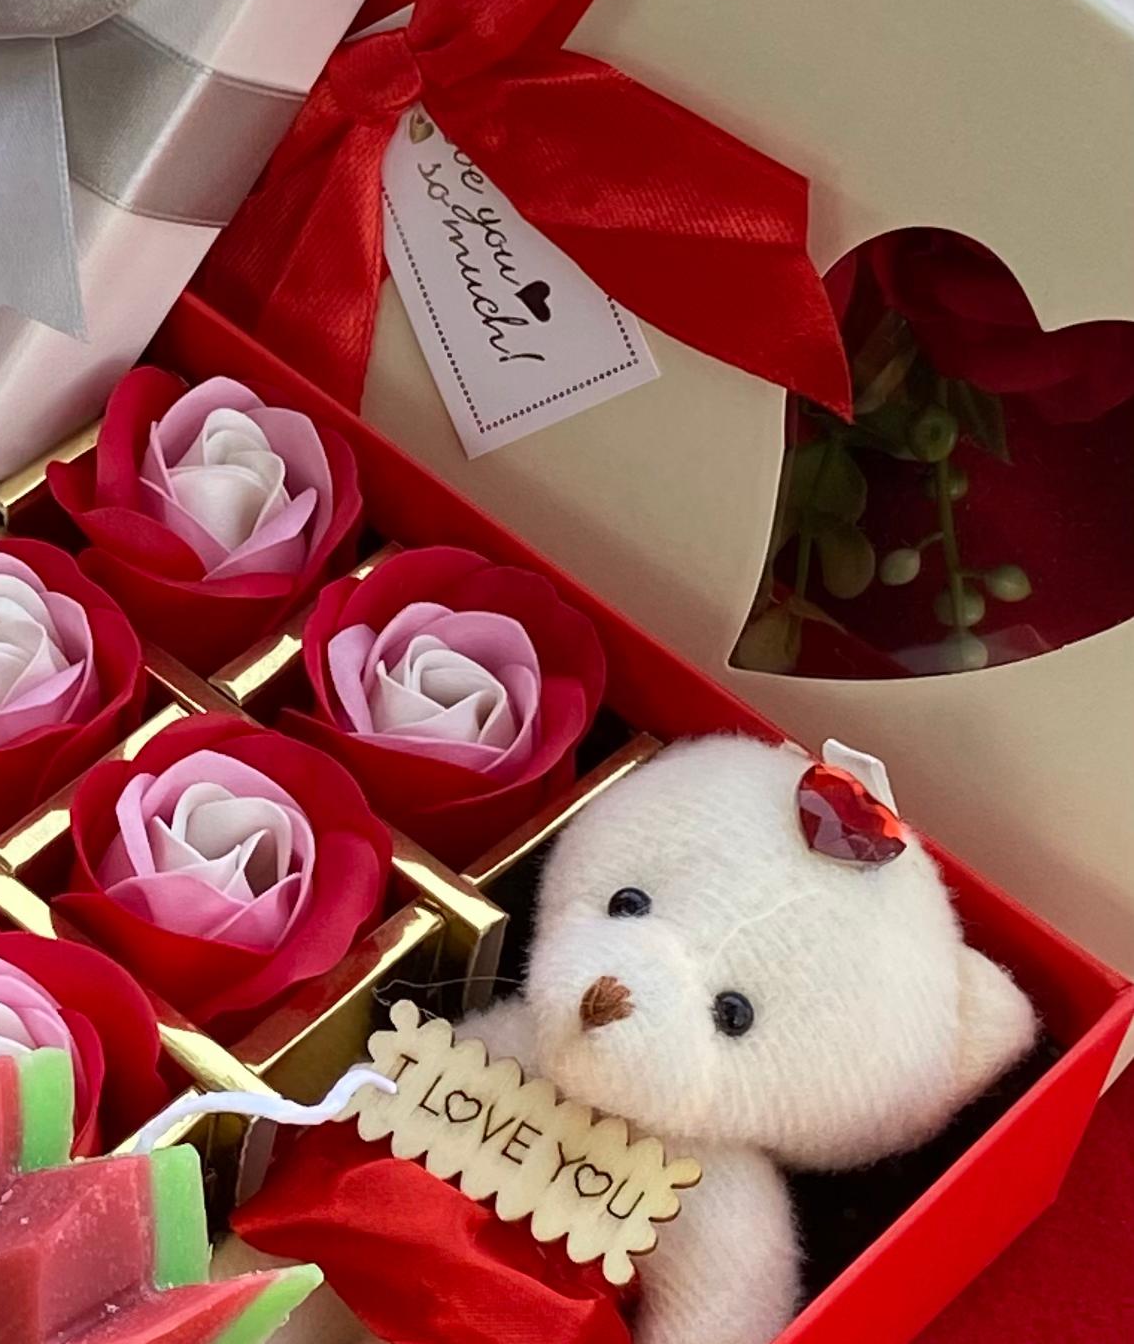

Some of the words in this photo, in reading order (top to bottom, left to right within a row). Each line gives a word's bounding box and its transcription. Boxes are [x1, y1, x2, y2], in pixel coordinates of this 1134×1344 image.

[417, 162, 452, 207] so
[441, 218, 546, 363] much!
[451, 203, 521, 287] you
